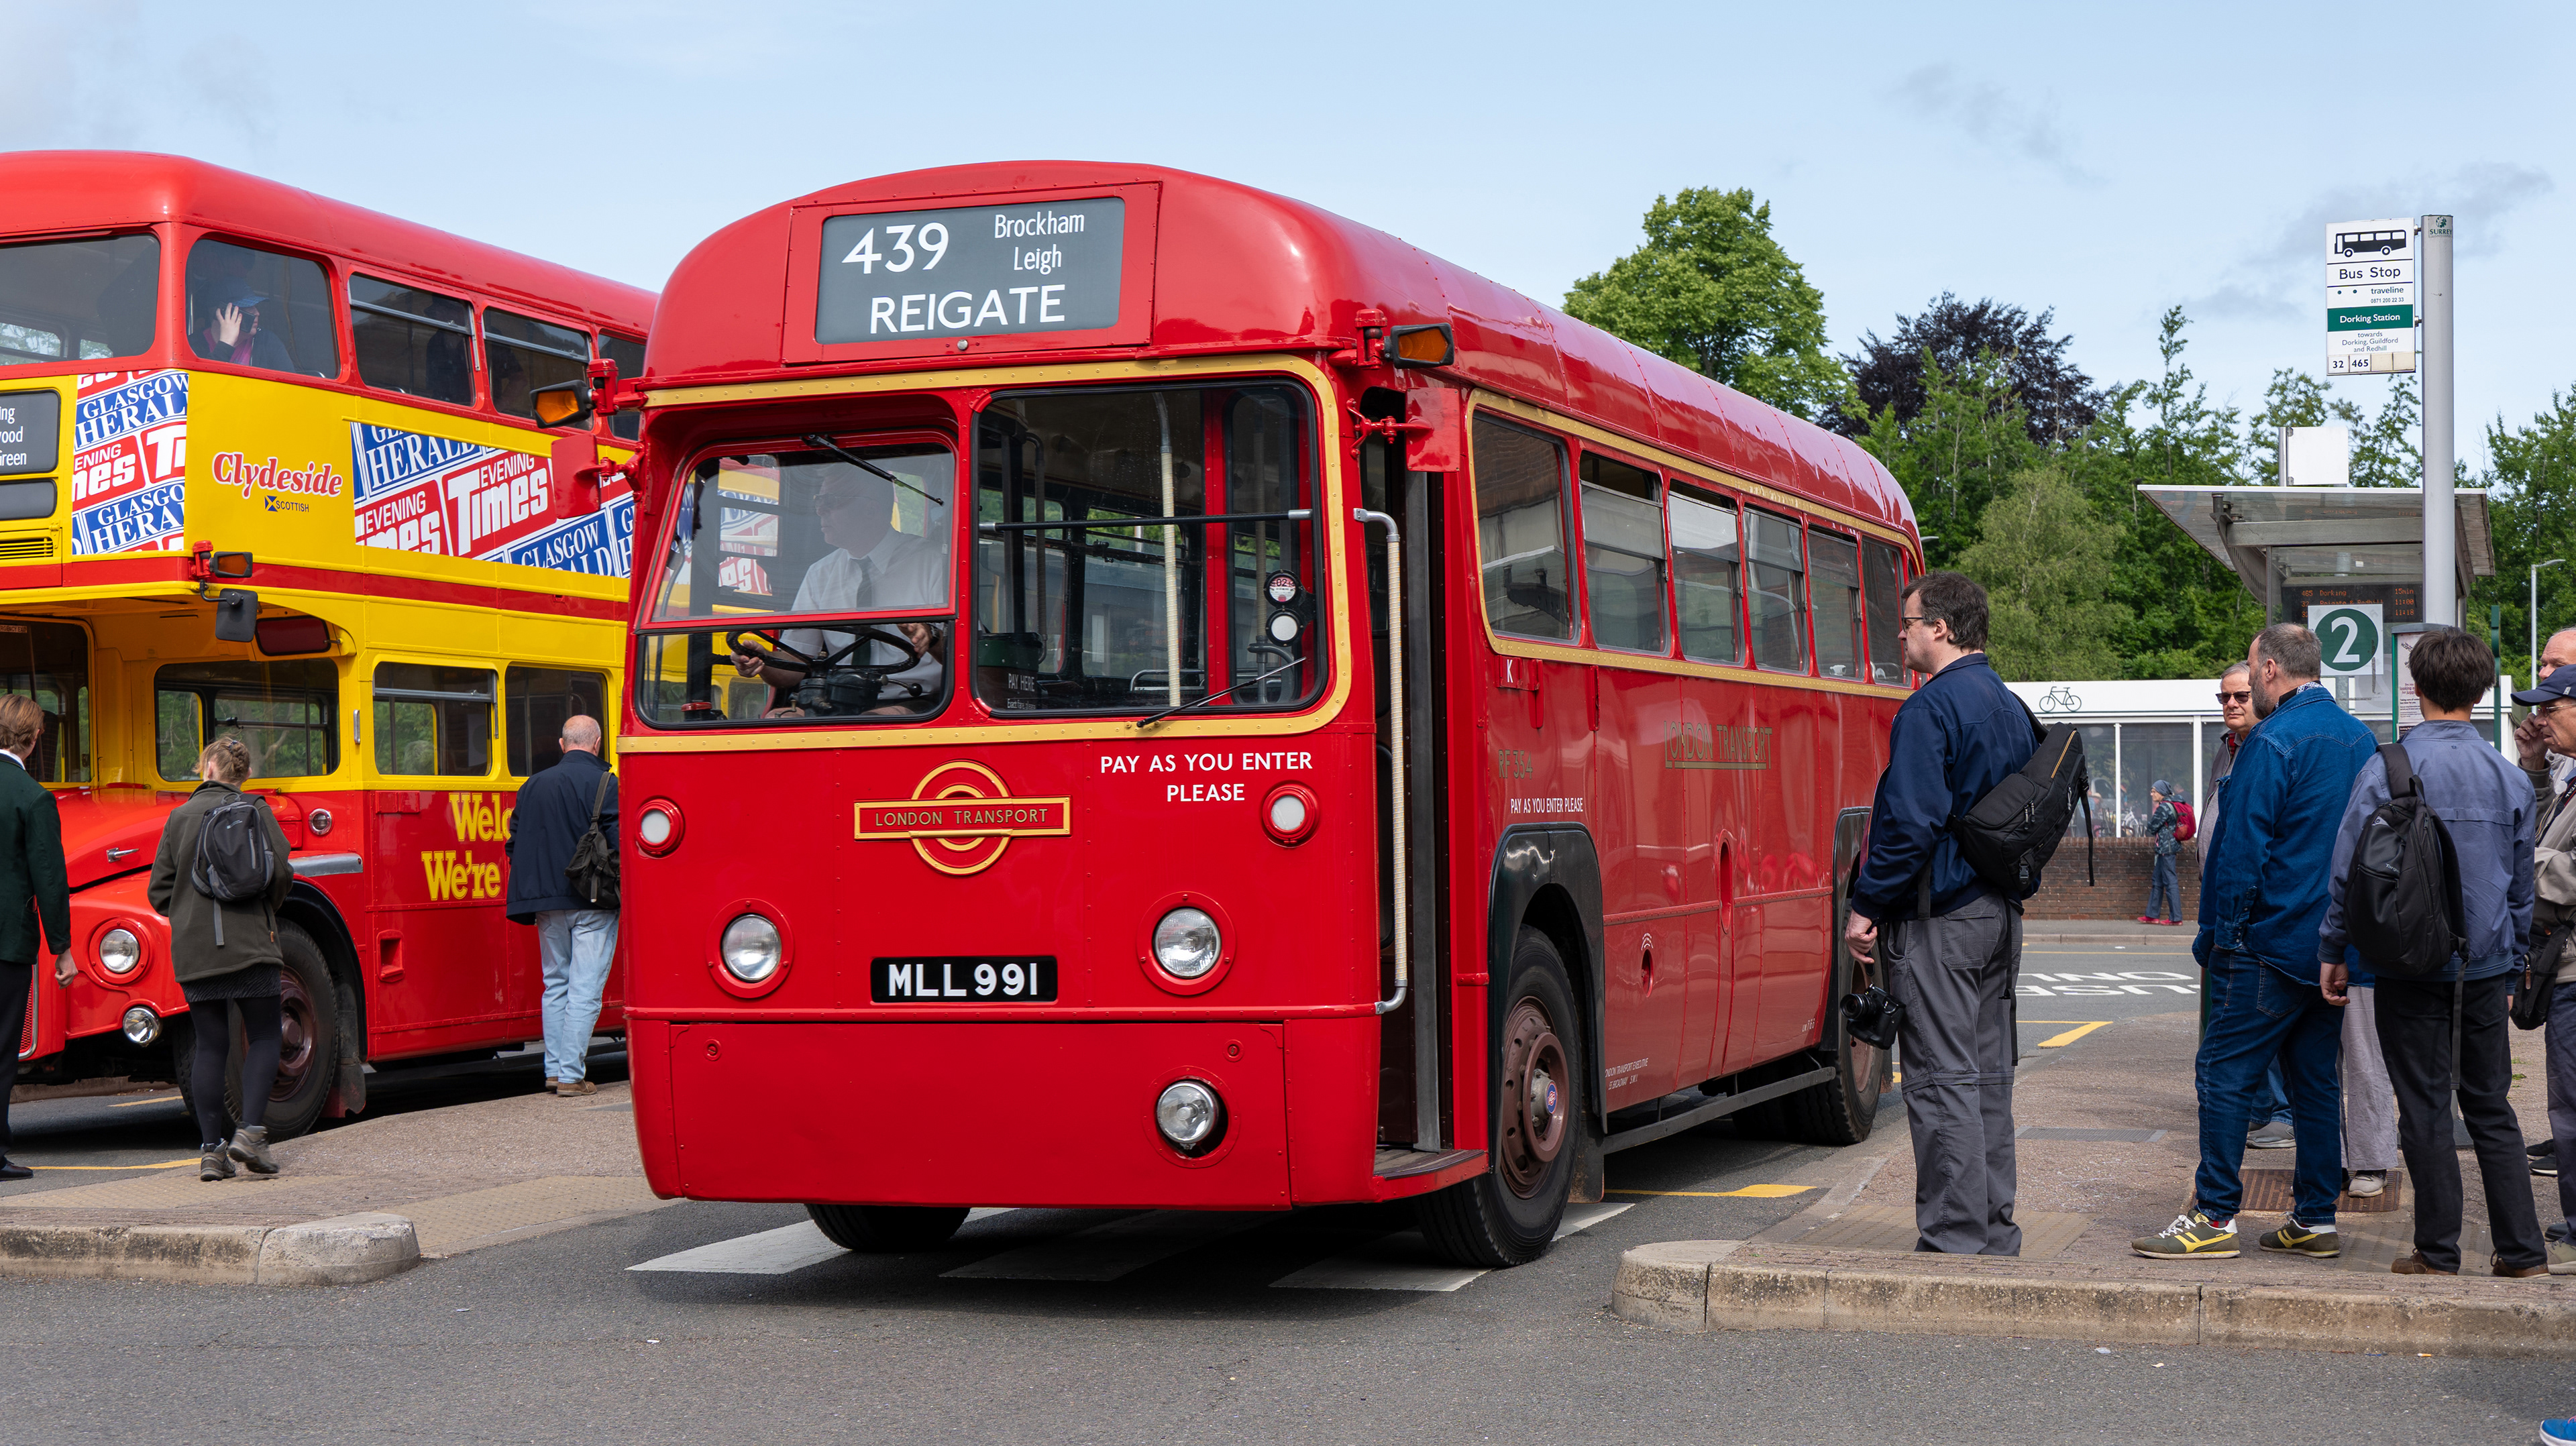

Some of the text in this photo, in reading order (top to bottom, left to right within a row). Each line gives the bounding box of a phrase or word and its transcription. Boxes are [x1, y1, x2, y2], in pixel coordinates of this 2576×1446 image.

[842, 211, 1085, 274] 439 Brockham
[1014, 244, 1062, 276] Leigh
[2339, 267, 2401, 280] Bus Stop
[2371, 286, 2404, 294] traveline
[870, 284, 1065, 335] REIGATE
[2340, 315, 2371, 324] Dorking
[2332, 359, 2369, 368] 32 465
[83, 374, 189, 420] GLASGOW
[0, 426, 23, 443] ood
[0, 450, 27, 466] reen
[213, 452, 343, 500] Clydeside
[480, 453, 535, 488] EVENING
[276, 500, 310, 513] SCOTTISH
[366, 490, 426, 535] EVENING
[447, 467, 549, 557] Times
[521, 521, 598, 569] GLASGOW
[2330, 616, 2360, 663] 2
[1008, 673, 1035, 691] PAY HERE
[1506, 659, 1513, 683] K
[1664, 720, 1773, 769] LONDON TRANSPORT
[1100, 751, 1313, 774] PAY AS YOU ENTER
[1499, 749, 1534, 780] RF 354
[1167, 783, 1245, 803] PLEASE
[875, 808, 1049, 827] LONDON TRANSPORT
[1511, 797, 1584, 814] PAY AS YOU ENTER PLEASE
[421, 850, 501, 901] We're
[888, 962, 1038, 997] MLL 991
[1616, 1062, 1633, 1075] TRANSPORT
[1632, 1057, 1649, 1071] EXECUTIVE
[1611, 1076, 1629, 1090] BROADWAY
